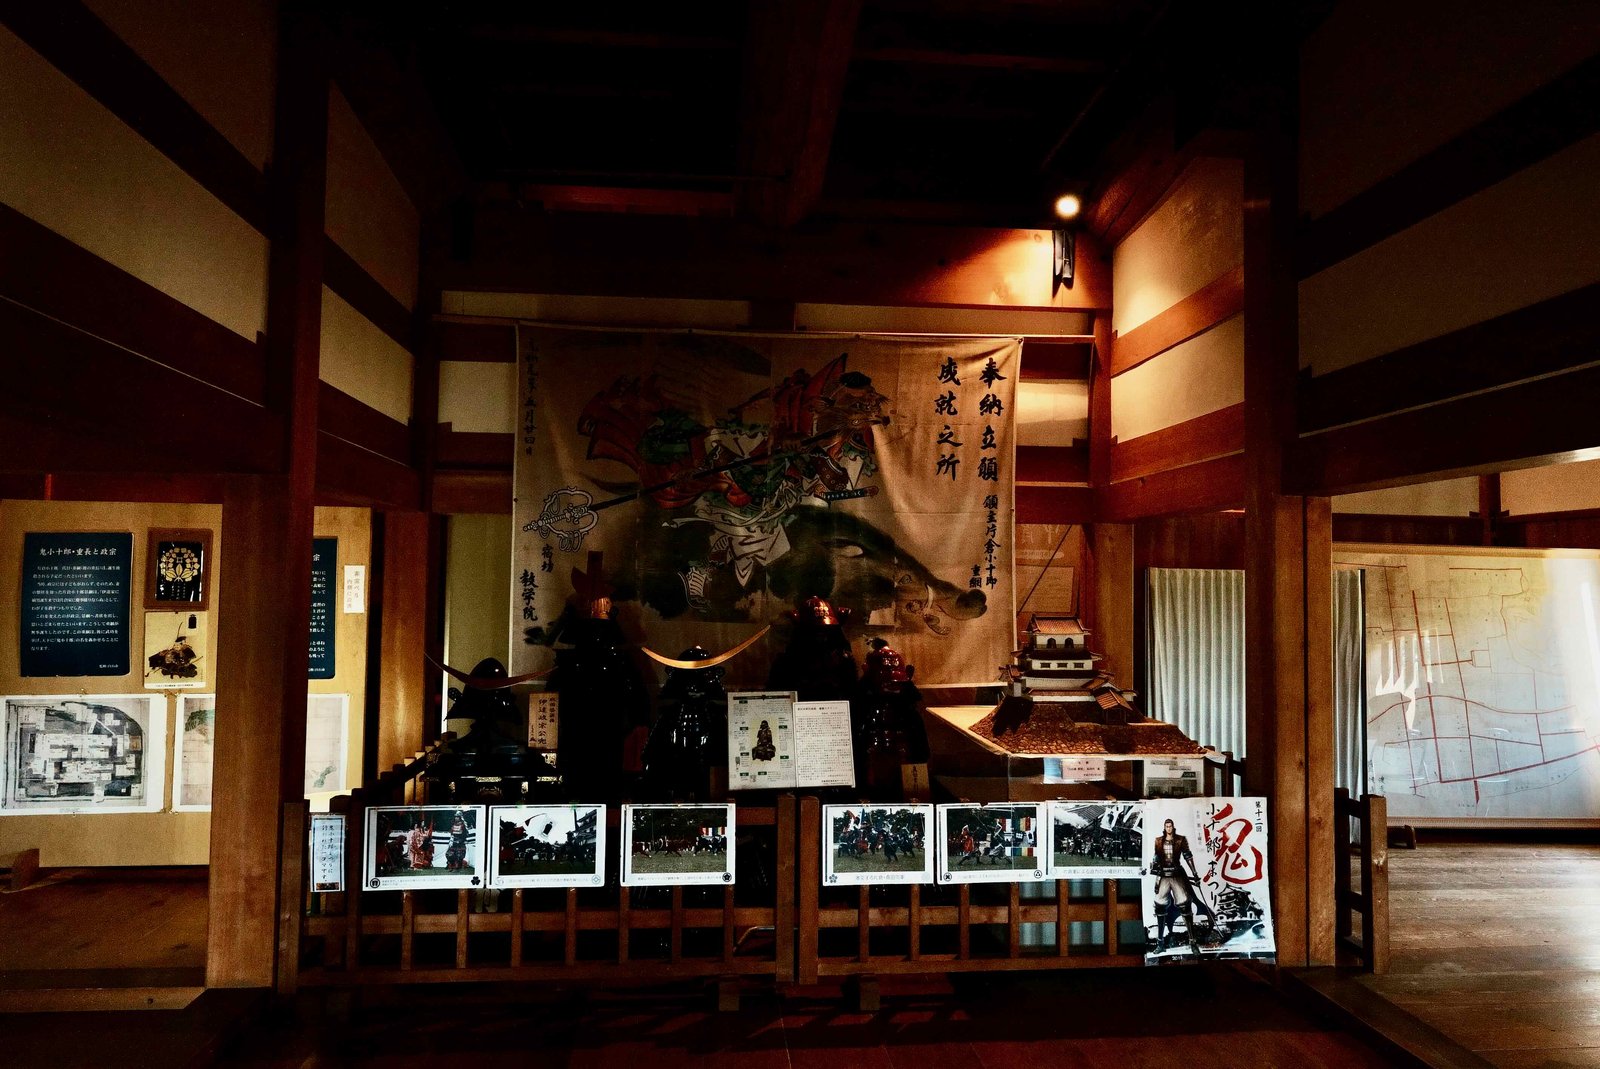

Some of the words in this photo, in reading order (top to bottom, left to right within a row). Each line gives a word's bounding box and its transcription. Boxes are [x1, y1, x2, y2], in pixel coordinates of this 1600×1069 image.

[934, 356, 962, 482] 成就之所
[978, 357, 1007, 482] 奉納立願
[1203, 803, 1263, 884] 鬼
[1205, 803, 1221, 908] 小十郎まつり
[1254, 801, 1264, 833] 第十二回
